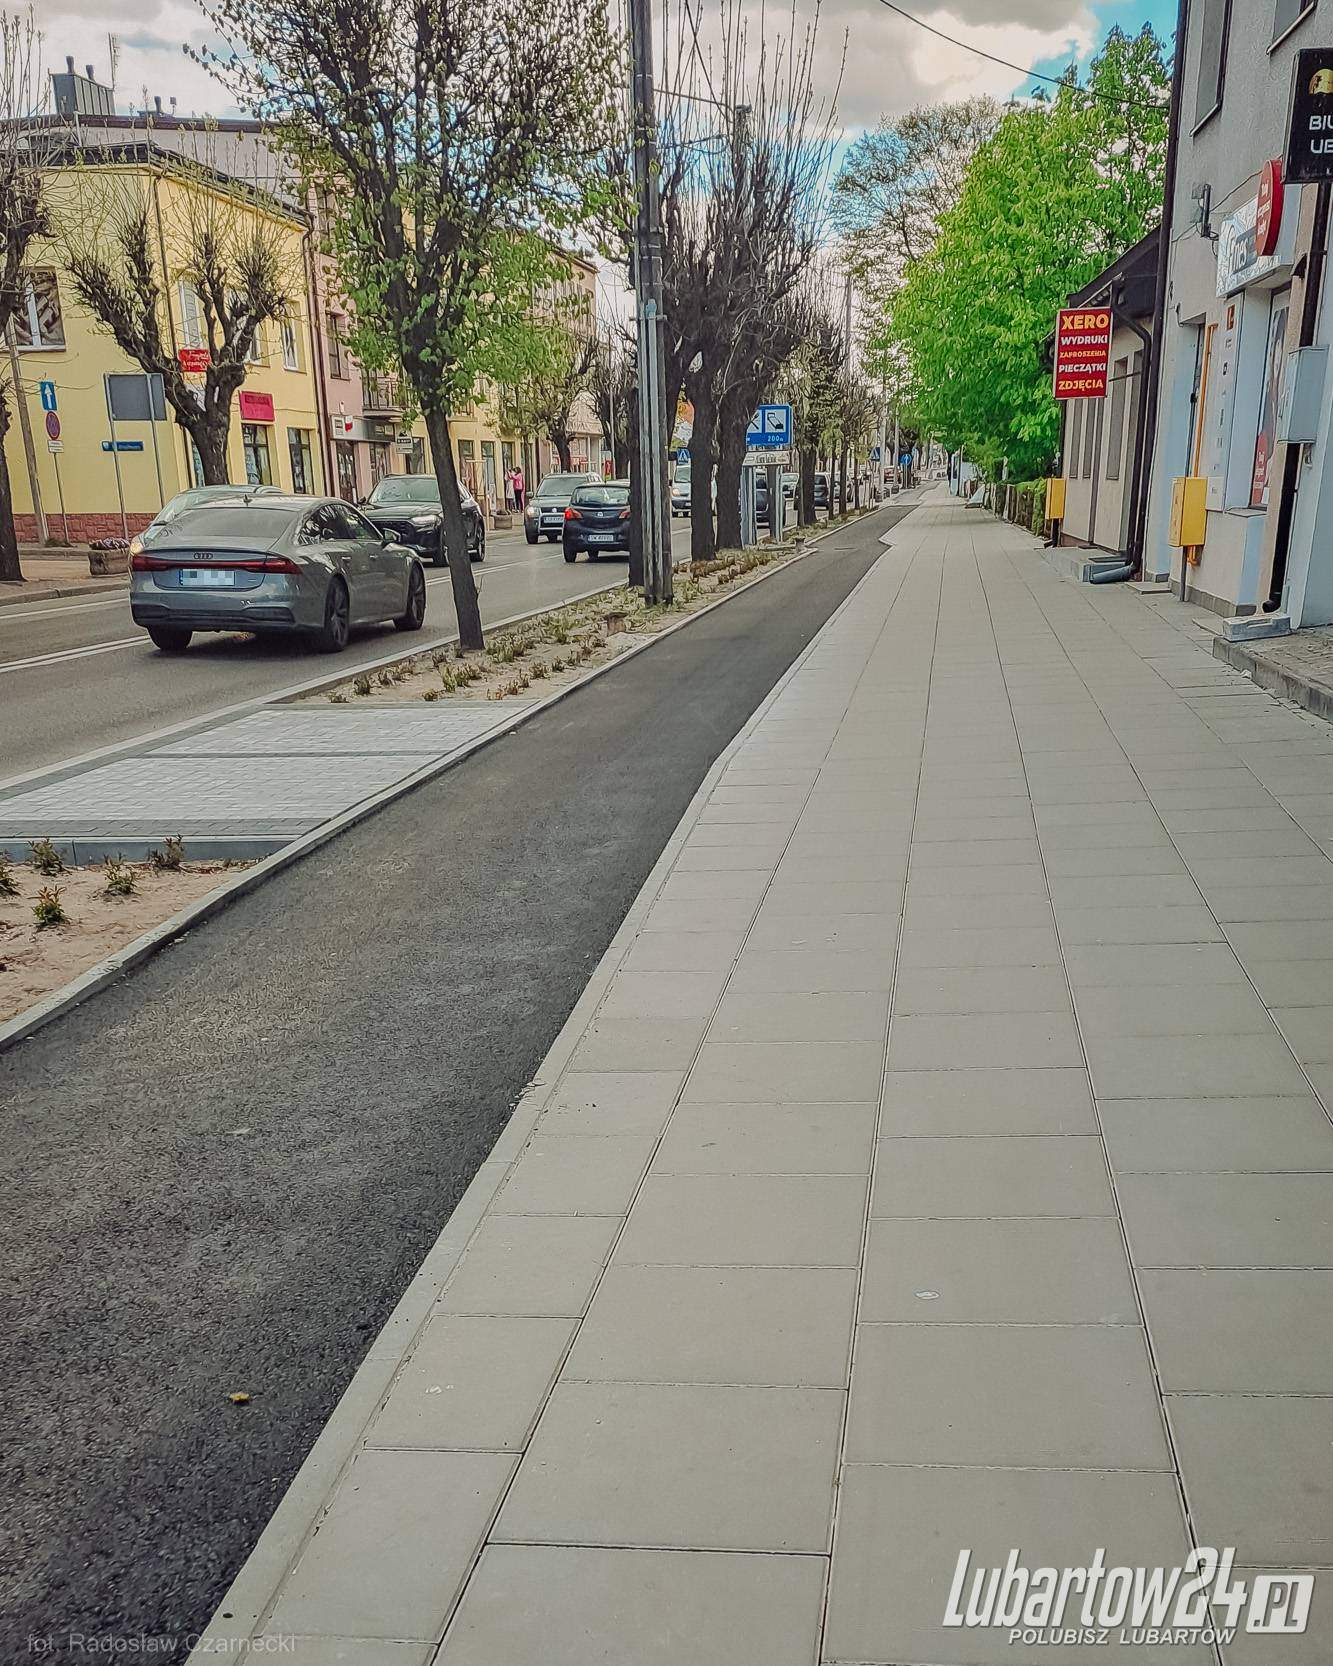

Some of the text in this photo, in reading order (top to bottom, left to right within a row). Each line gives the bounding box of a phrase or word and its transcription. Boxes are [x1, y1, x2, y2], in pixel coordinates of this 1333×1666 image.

[1061, 313, 1109, 330] XERO
[1060, 335, 1108, 345] WYDRUKI
[1060, 350, 1107, 358] ZAPROSZENIA
[1058, 363, 1107, 374] PIECZĄTKI
[1058, 380, 1104, 392] ZDJĘCIA
